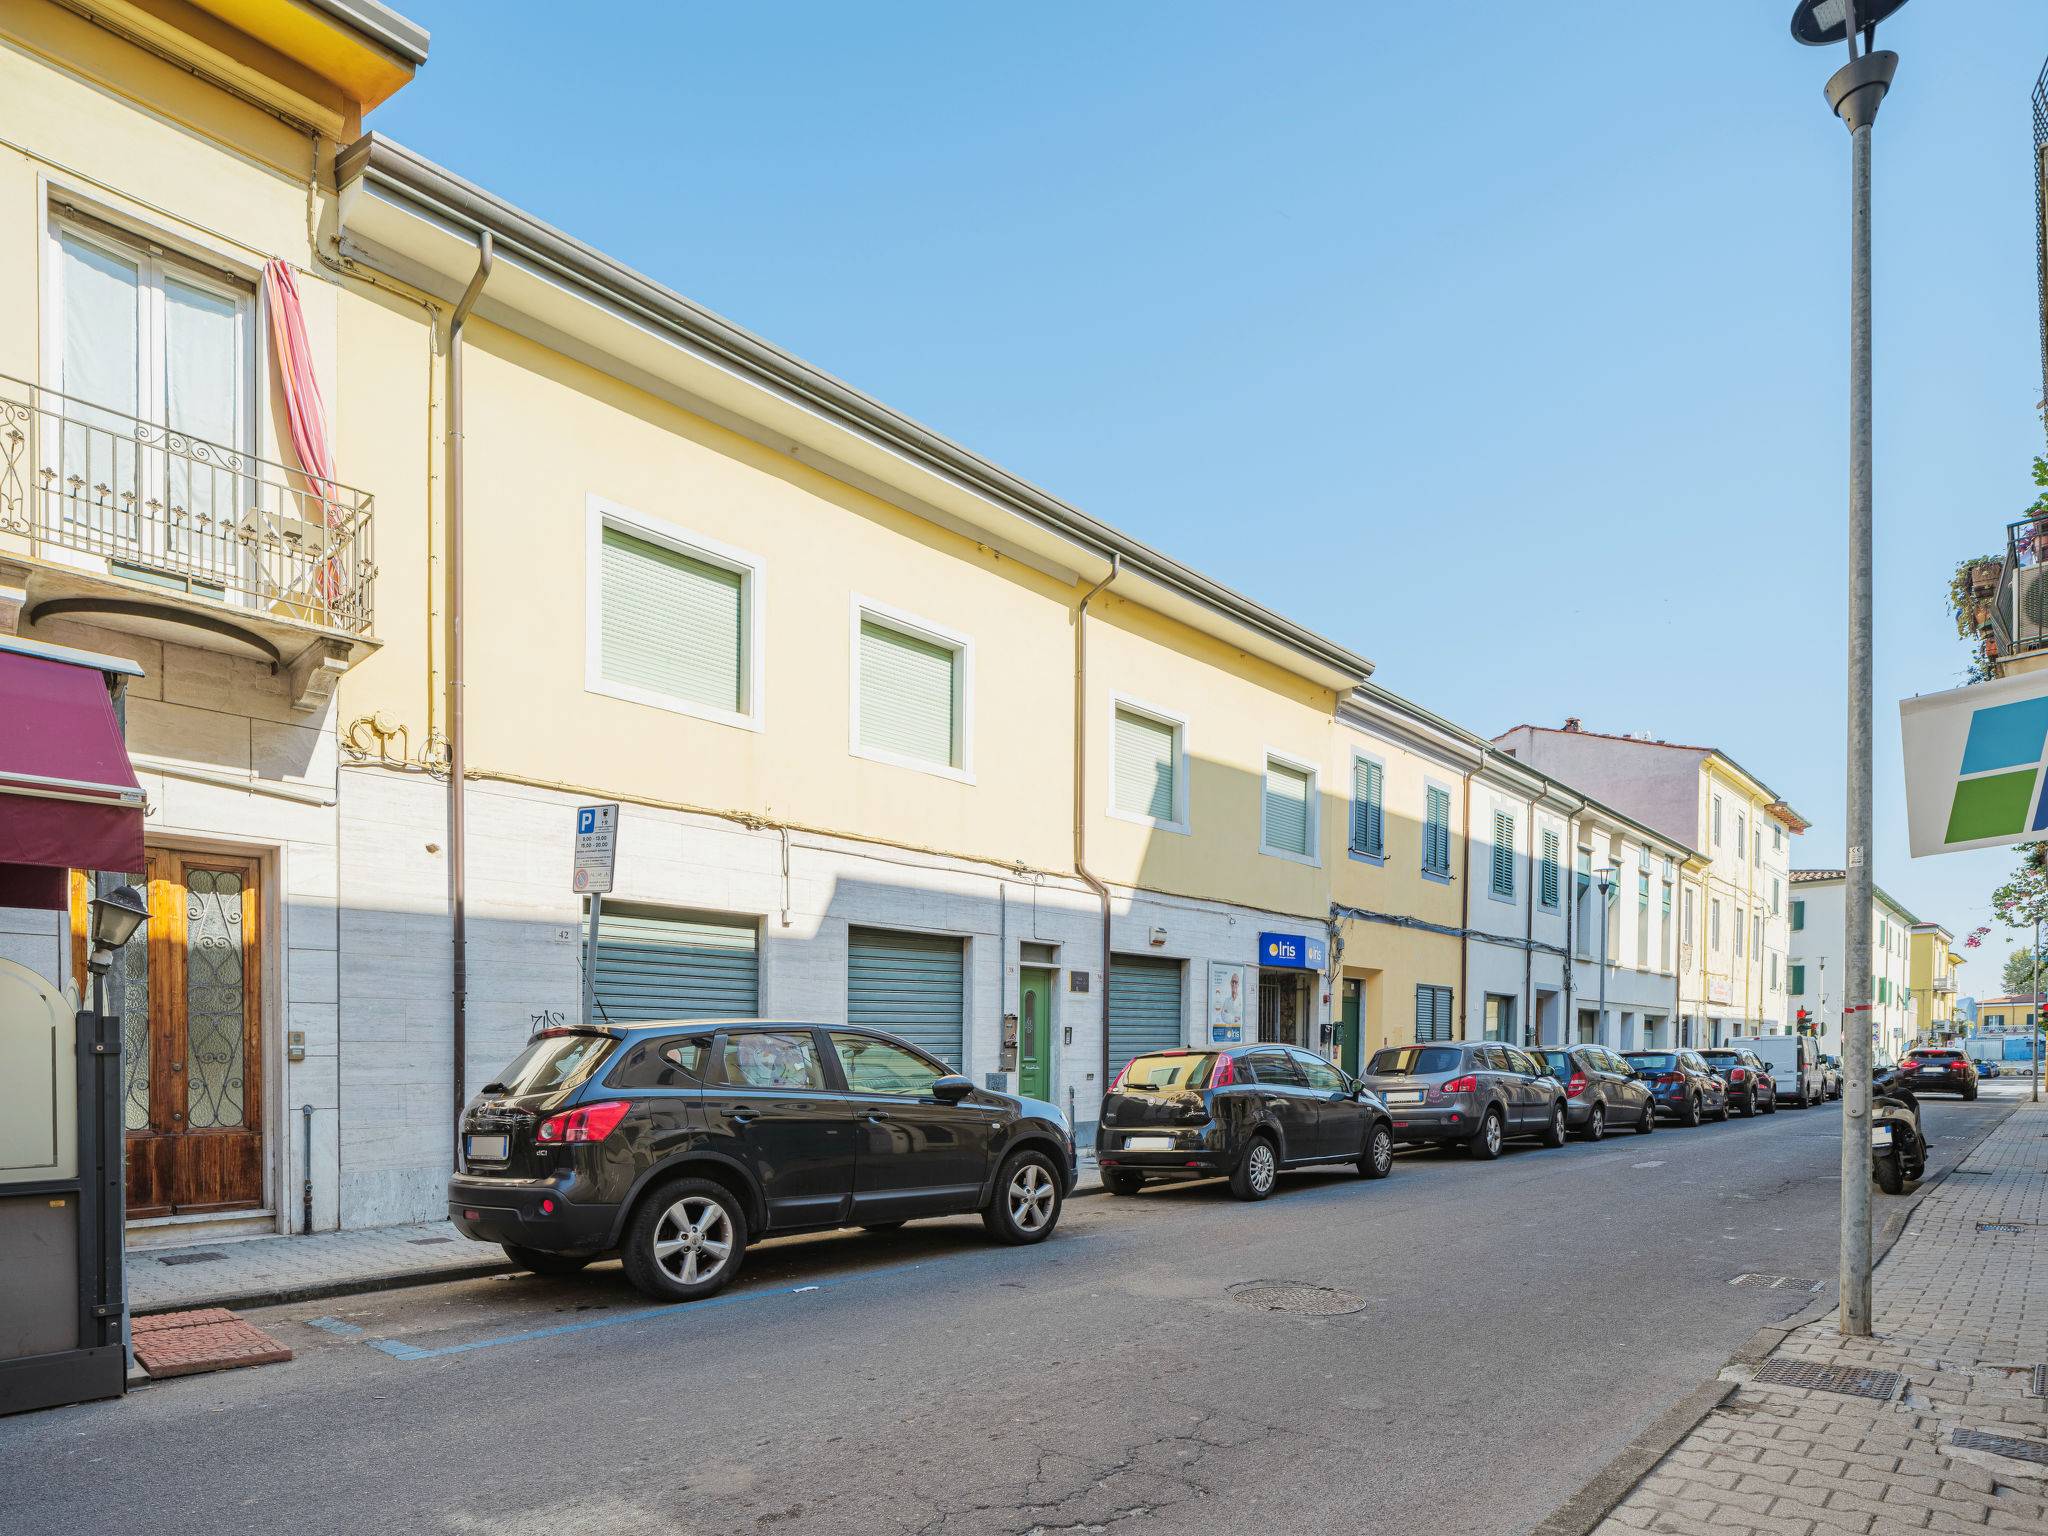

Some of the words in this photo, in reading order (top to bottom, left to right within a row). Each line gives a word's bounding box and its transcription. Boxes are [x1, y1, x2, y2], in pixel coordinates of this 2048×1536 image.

[581, 813, 592, 831] P
[558, 930, 569, 939] 42
[1279, 940, 1296, 957] Iris
